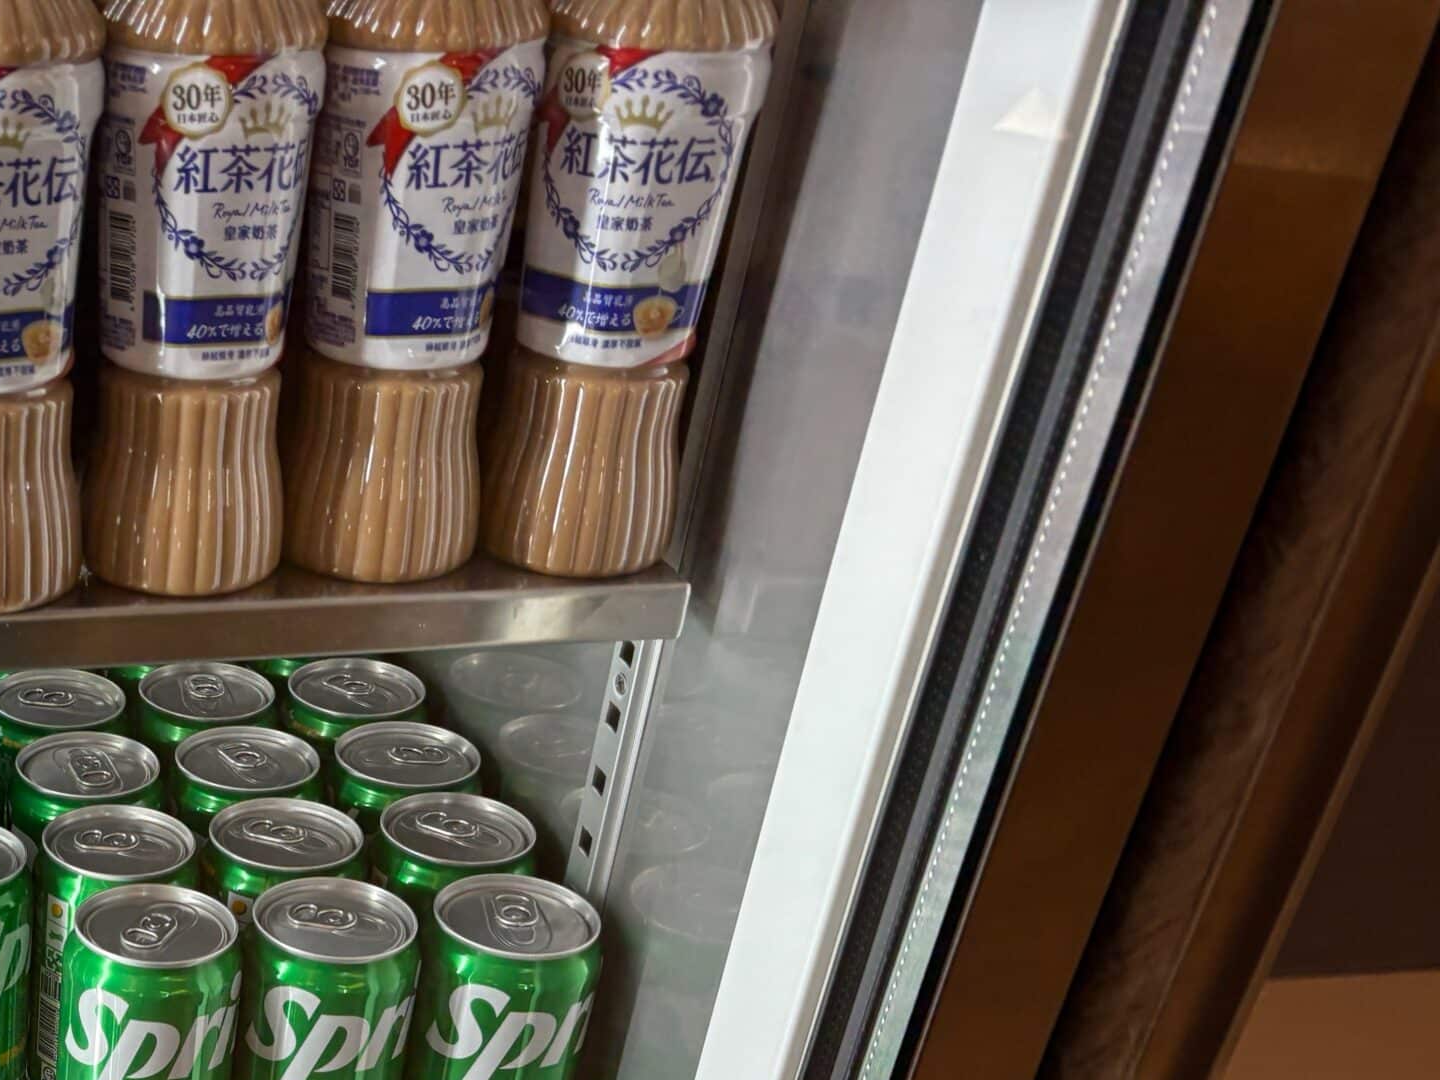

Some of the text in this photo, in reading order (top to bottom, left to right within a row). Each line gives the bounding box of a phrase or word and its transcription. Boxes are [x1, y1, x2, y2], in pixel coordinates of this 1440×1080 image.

[563, 67, 601, 94] 30年
[172, 83, 223, 111] 30年
[407, 81, 456, 110] 30年
[560, 127, 715, 186] 紅茶花伝
